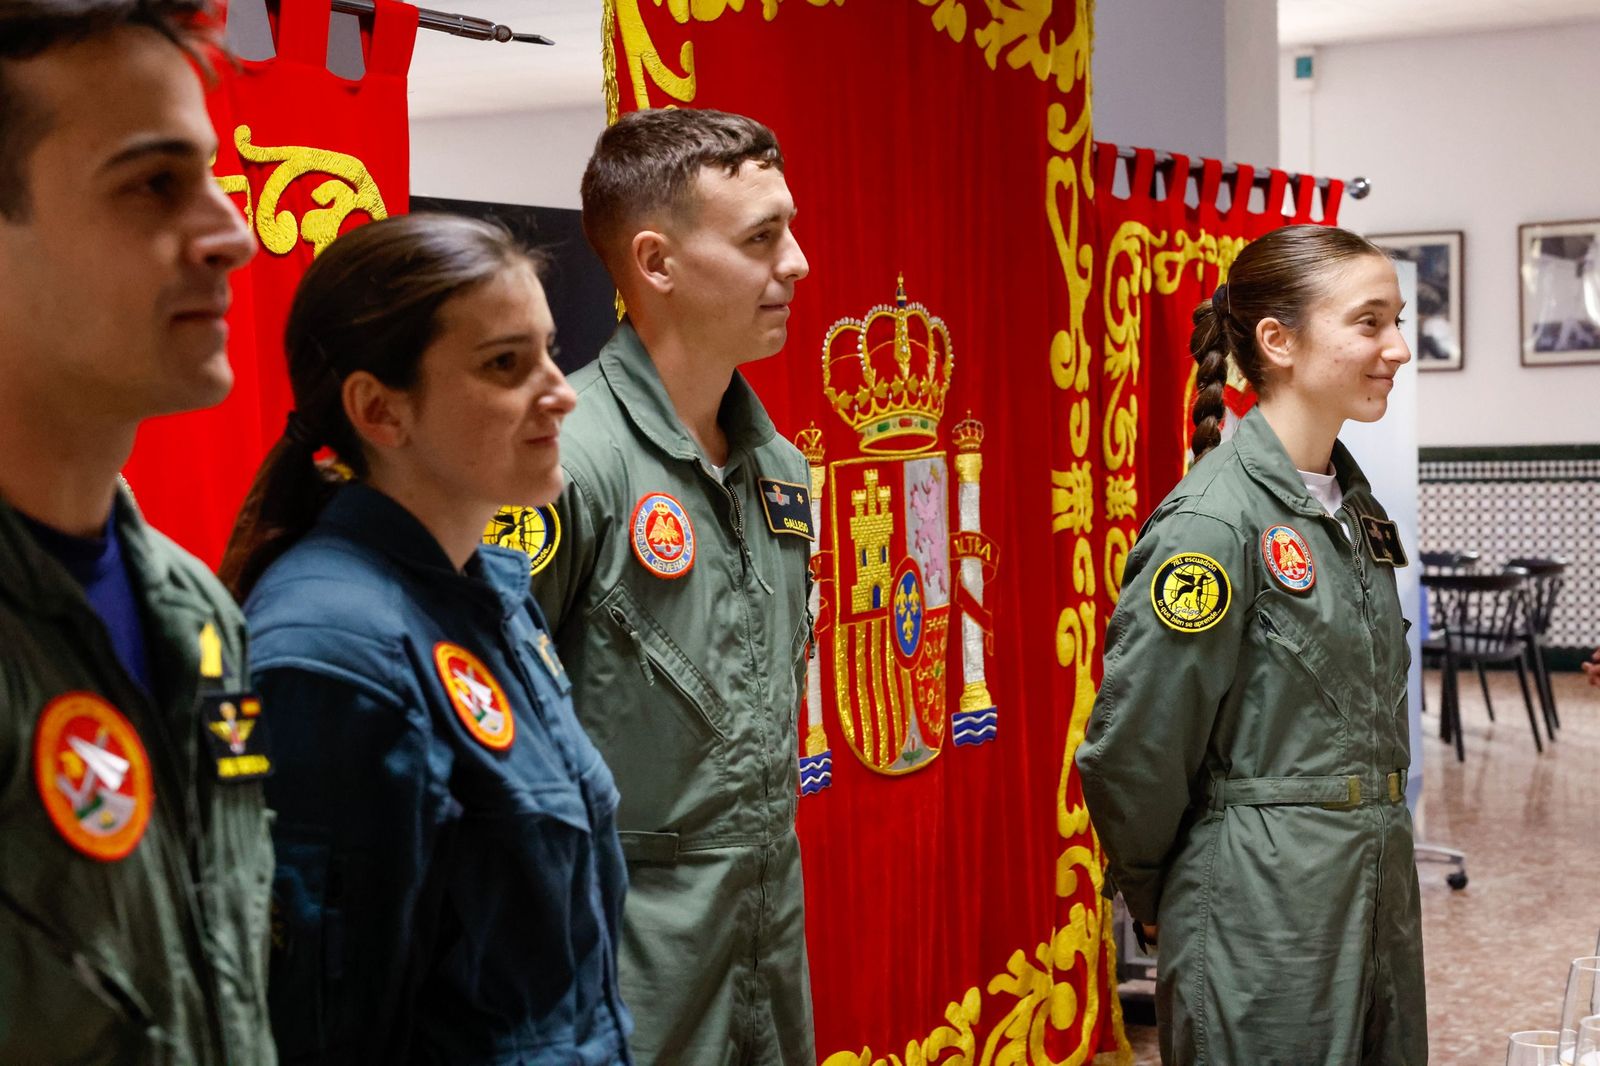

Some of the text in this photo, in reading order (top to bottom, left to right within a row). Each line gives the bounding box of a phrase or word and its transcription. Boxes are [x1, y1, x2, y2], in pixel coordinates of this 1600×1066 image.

[636, 508, 651, 559] ACADEMIA
[651, 557, 689, 572] GENERAL
[1156, 599, 1164, 607] lo
[1160, 606, 1172, 619] que
[1170, 616, 1184, 627] bien
